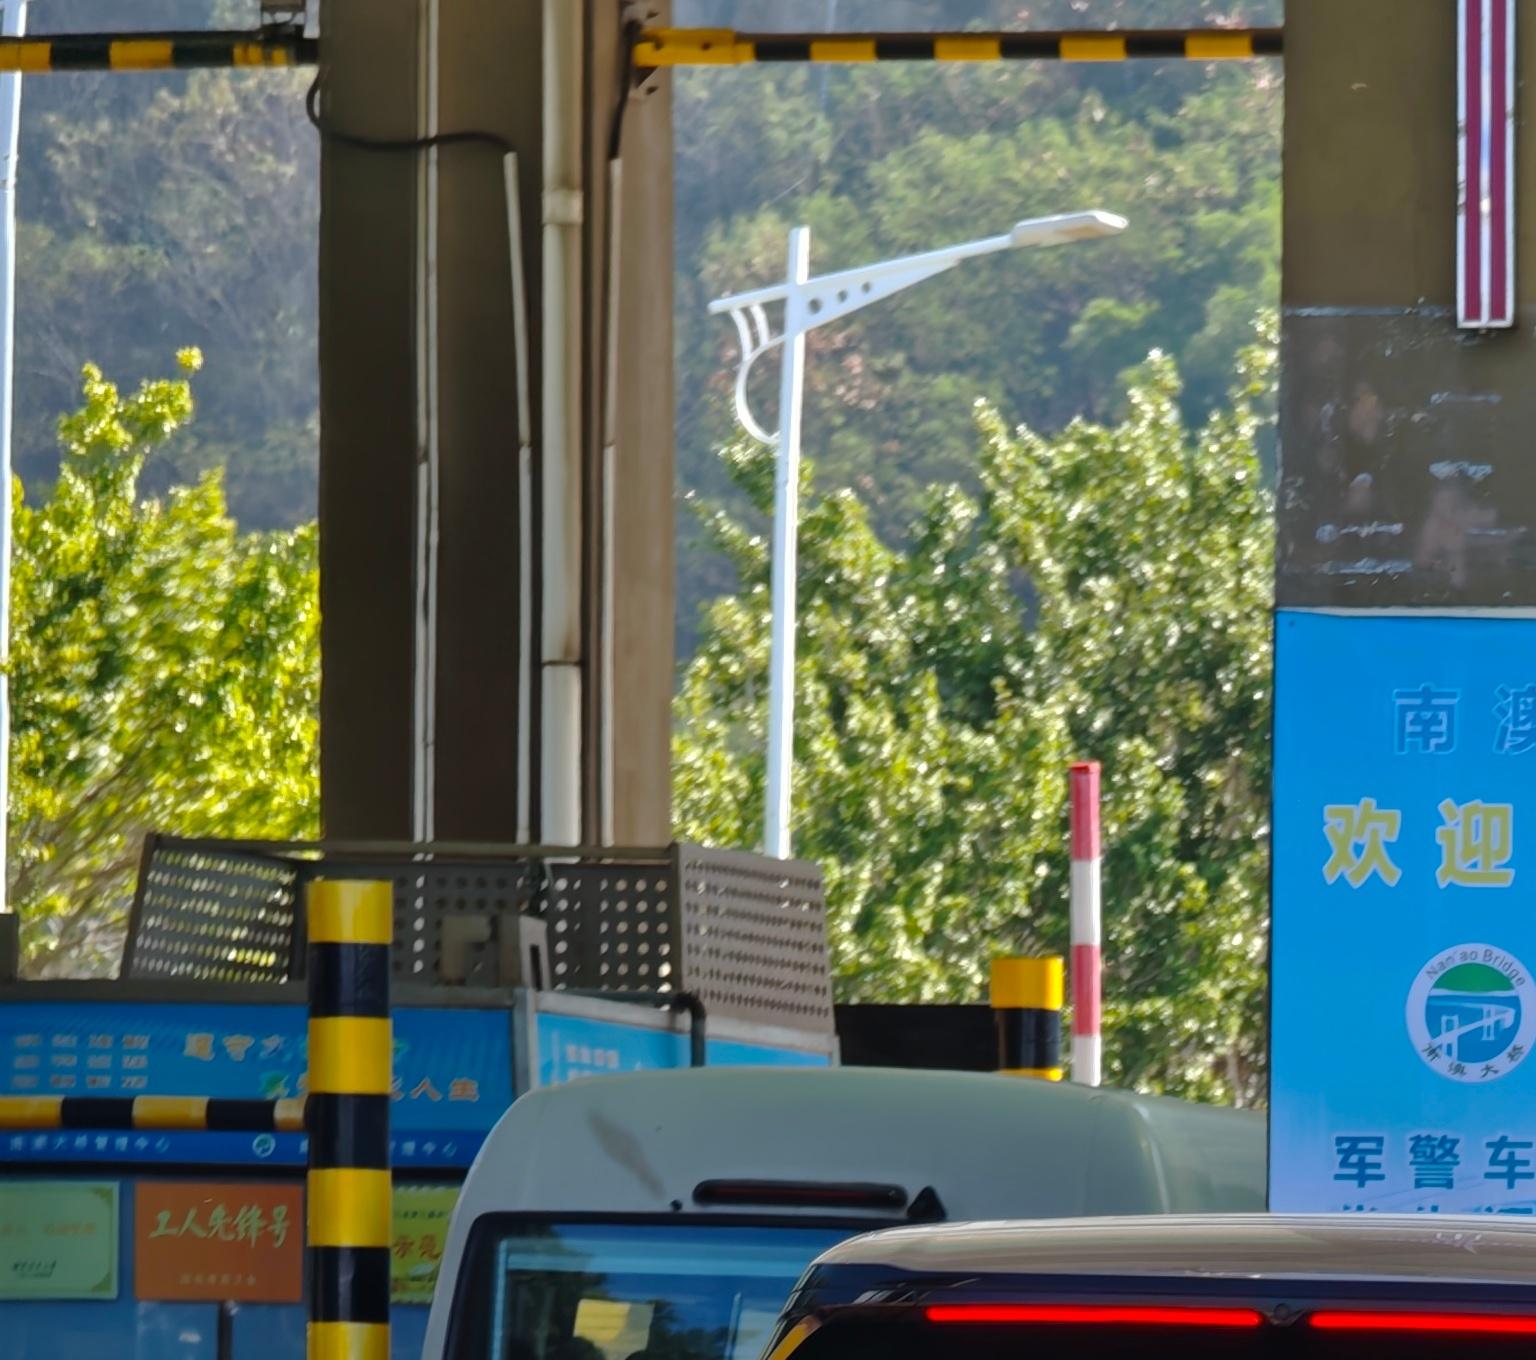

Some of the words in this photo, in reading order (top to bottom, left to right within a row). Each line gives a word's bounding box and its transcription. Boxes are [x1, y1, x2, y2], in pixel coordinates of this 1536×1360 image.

[1482, 948, 1526, 987] Bridge
[147, 1202, 291, 1249] 工人先锋号
